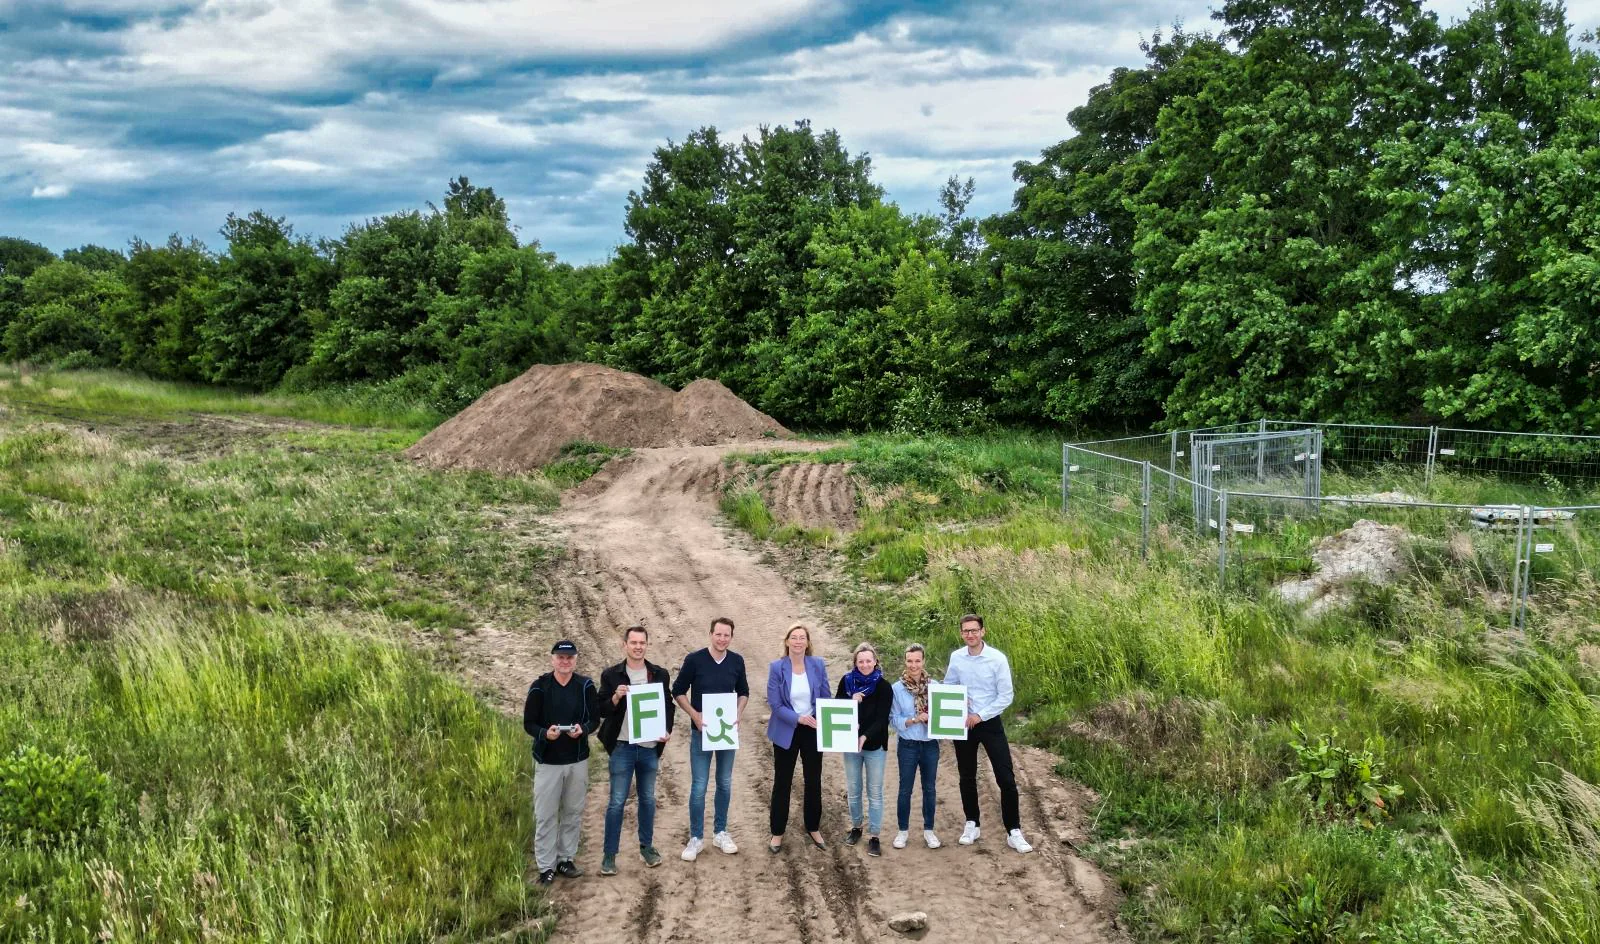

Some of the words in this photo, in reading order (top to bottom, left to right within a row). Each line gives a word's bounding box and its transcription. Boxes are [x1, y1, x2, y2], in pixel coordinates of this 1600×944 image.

[631, 692, 659, 738] F
[821, 706, 853, 748] F
[931, 692, 964, 735] E
